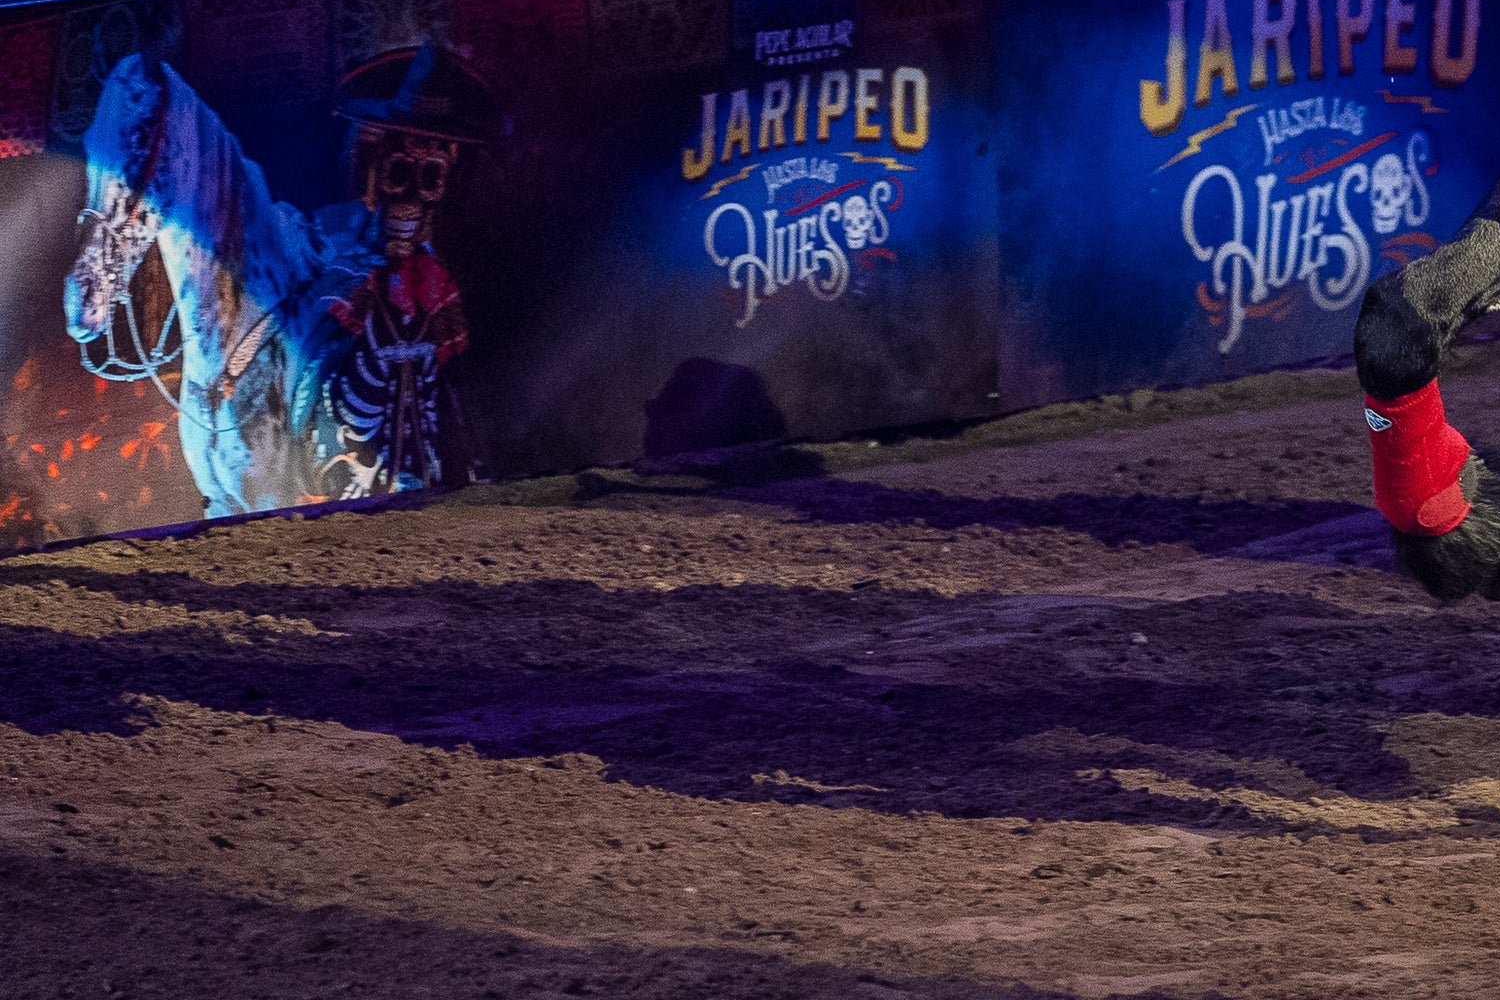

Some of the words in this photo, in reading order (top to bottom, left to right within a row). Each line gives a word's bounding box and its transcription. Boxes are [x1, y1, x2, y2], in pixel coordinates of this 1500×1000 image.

[755, 29, 791, 60] PEPE
[682, 66, 929, 181] JARIPEO
[1258, 97, 1327, 166] HASTA
